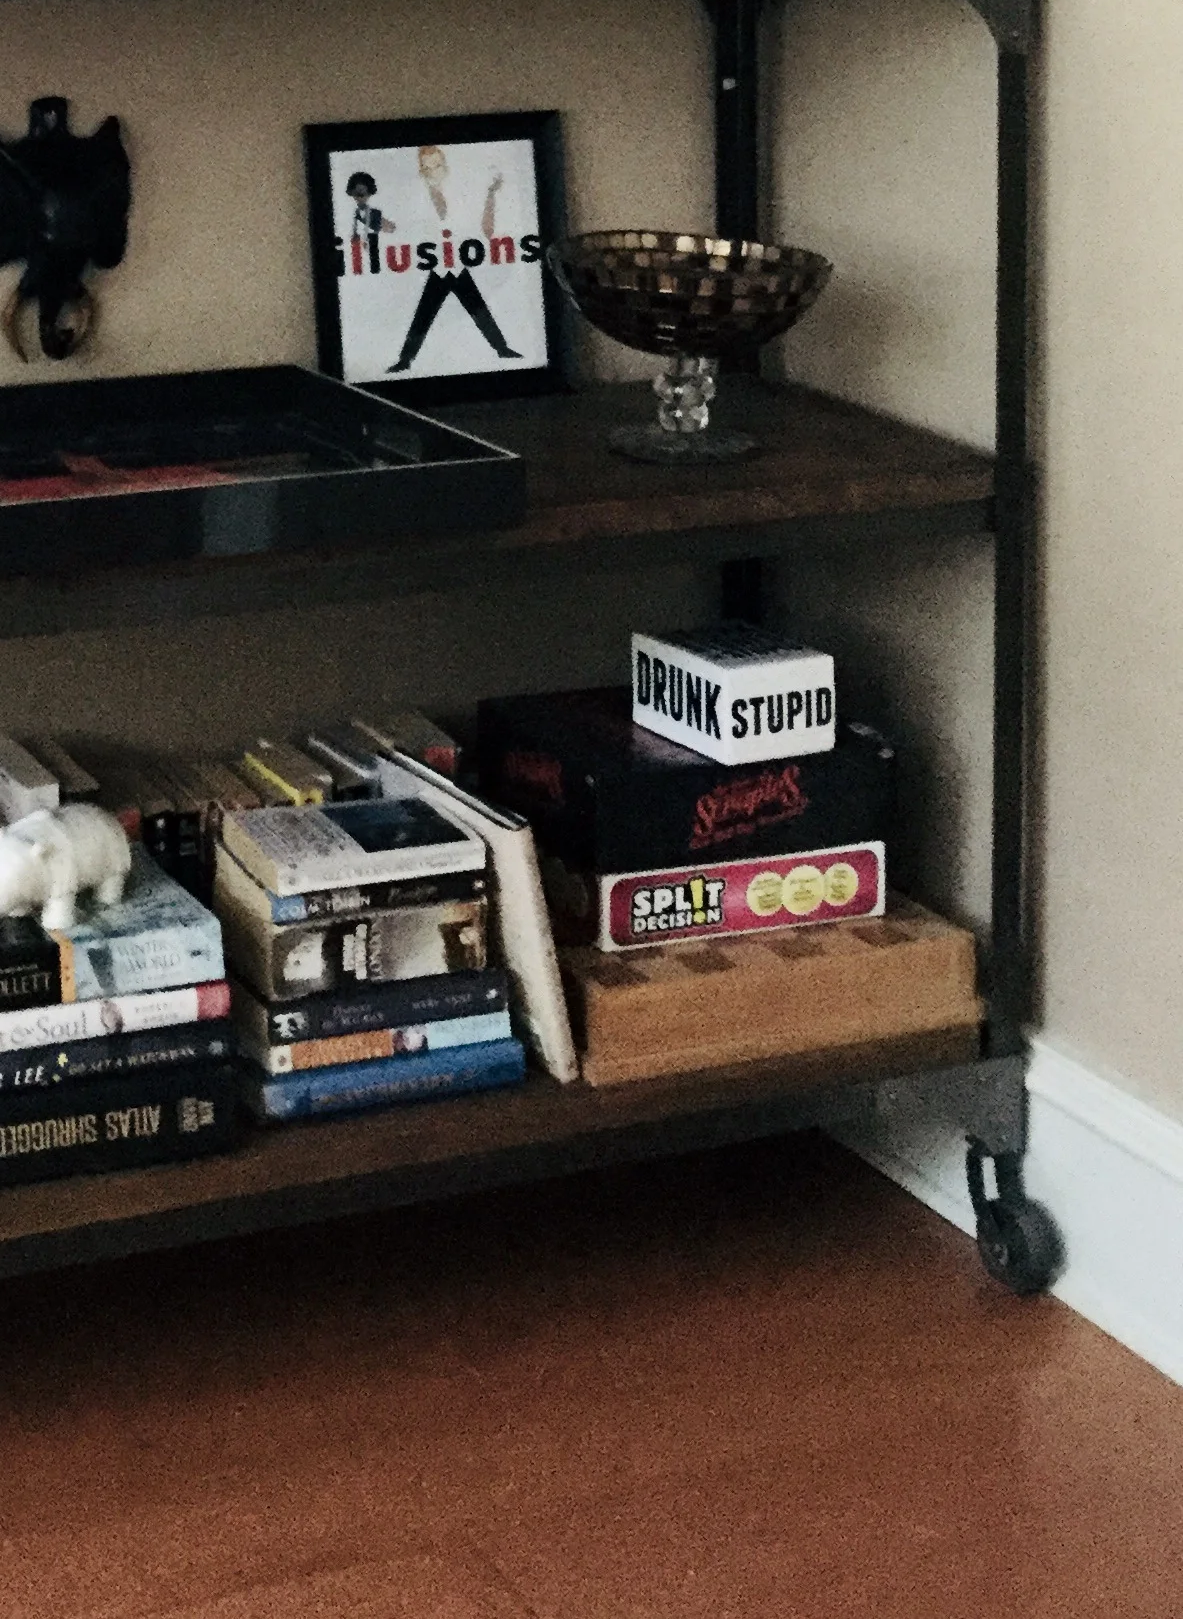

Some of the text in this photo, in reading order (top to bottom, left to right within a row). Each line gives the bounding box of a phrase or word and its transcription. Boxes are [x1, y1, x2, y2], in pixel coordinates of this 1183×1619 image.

[334, 229, 543, 278] illusions
[637, 650, 722, 740] DRUNK
[731, 687, 832, 740] STUPID
[35, 1009, 88, 1042] Soul
[14, 1064, 46, 1086] LEE
[104, 1103, 163, 1143] ATLAS
